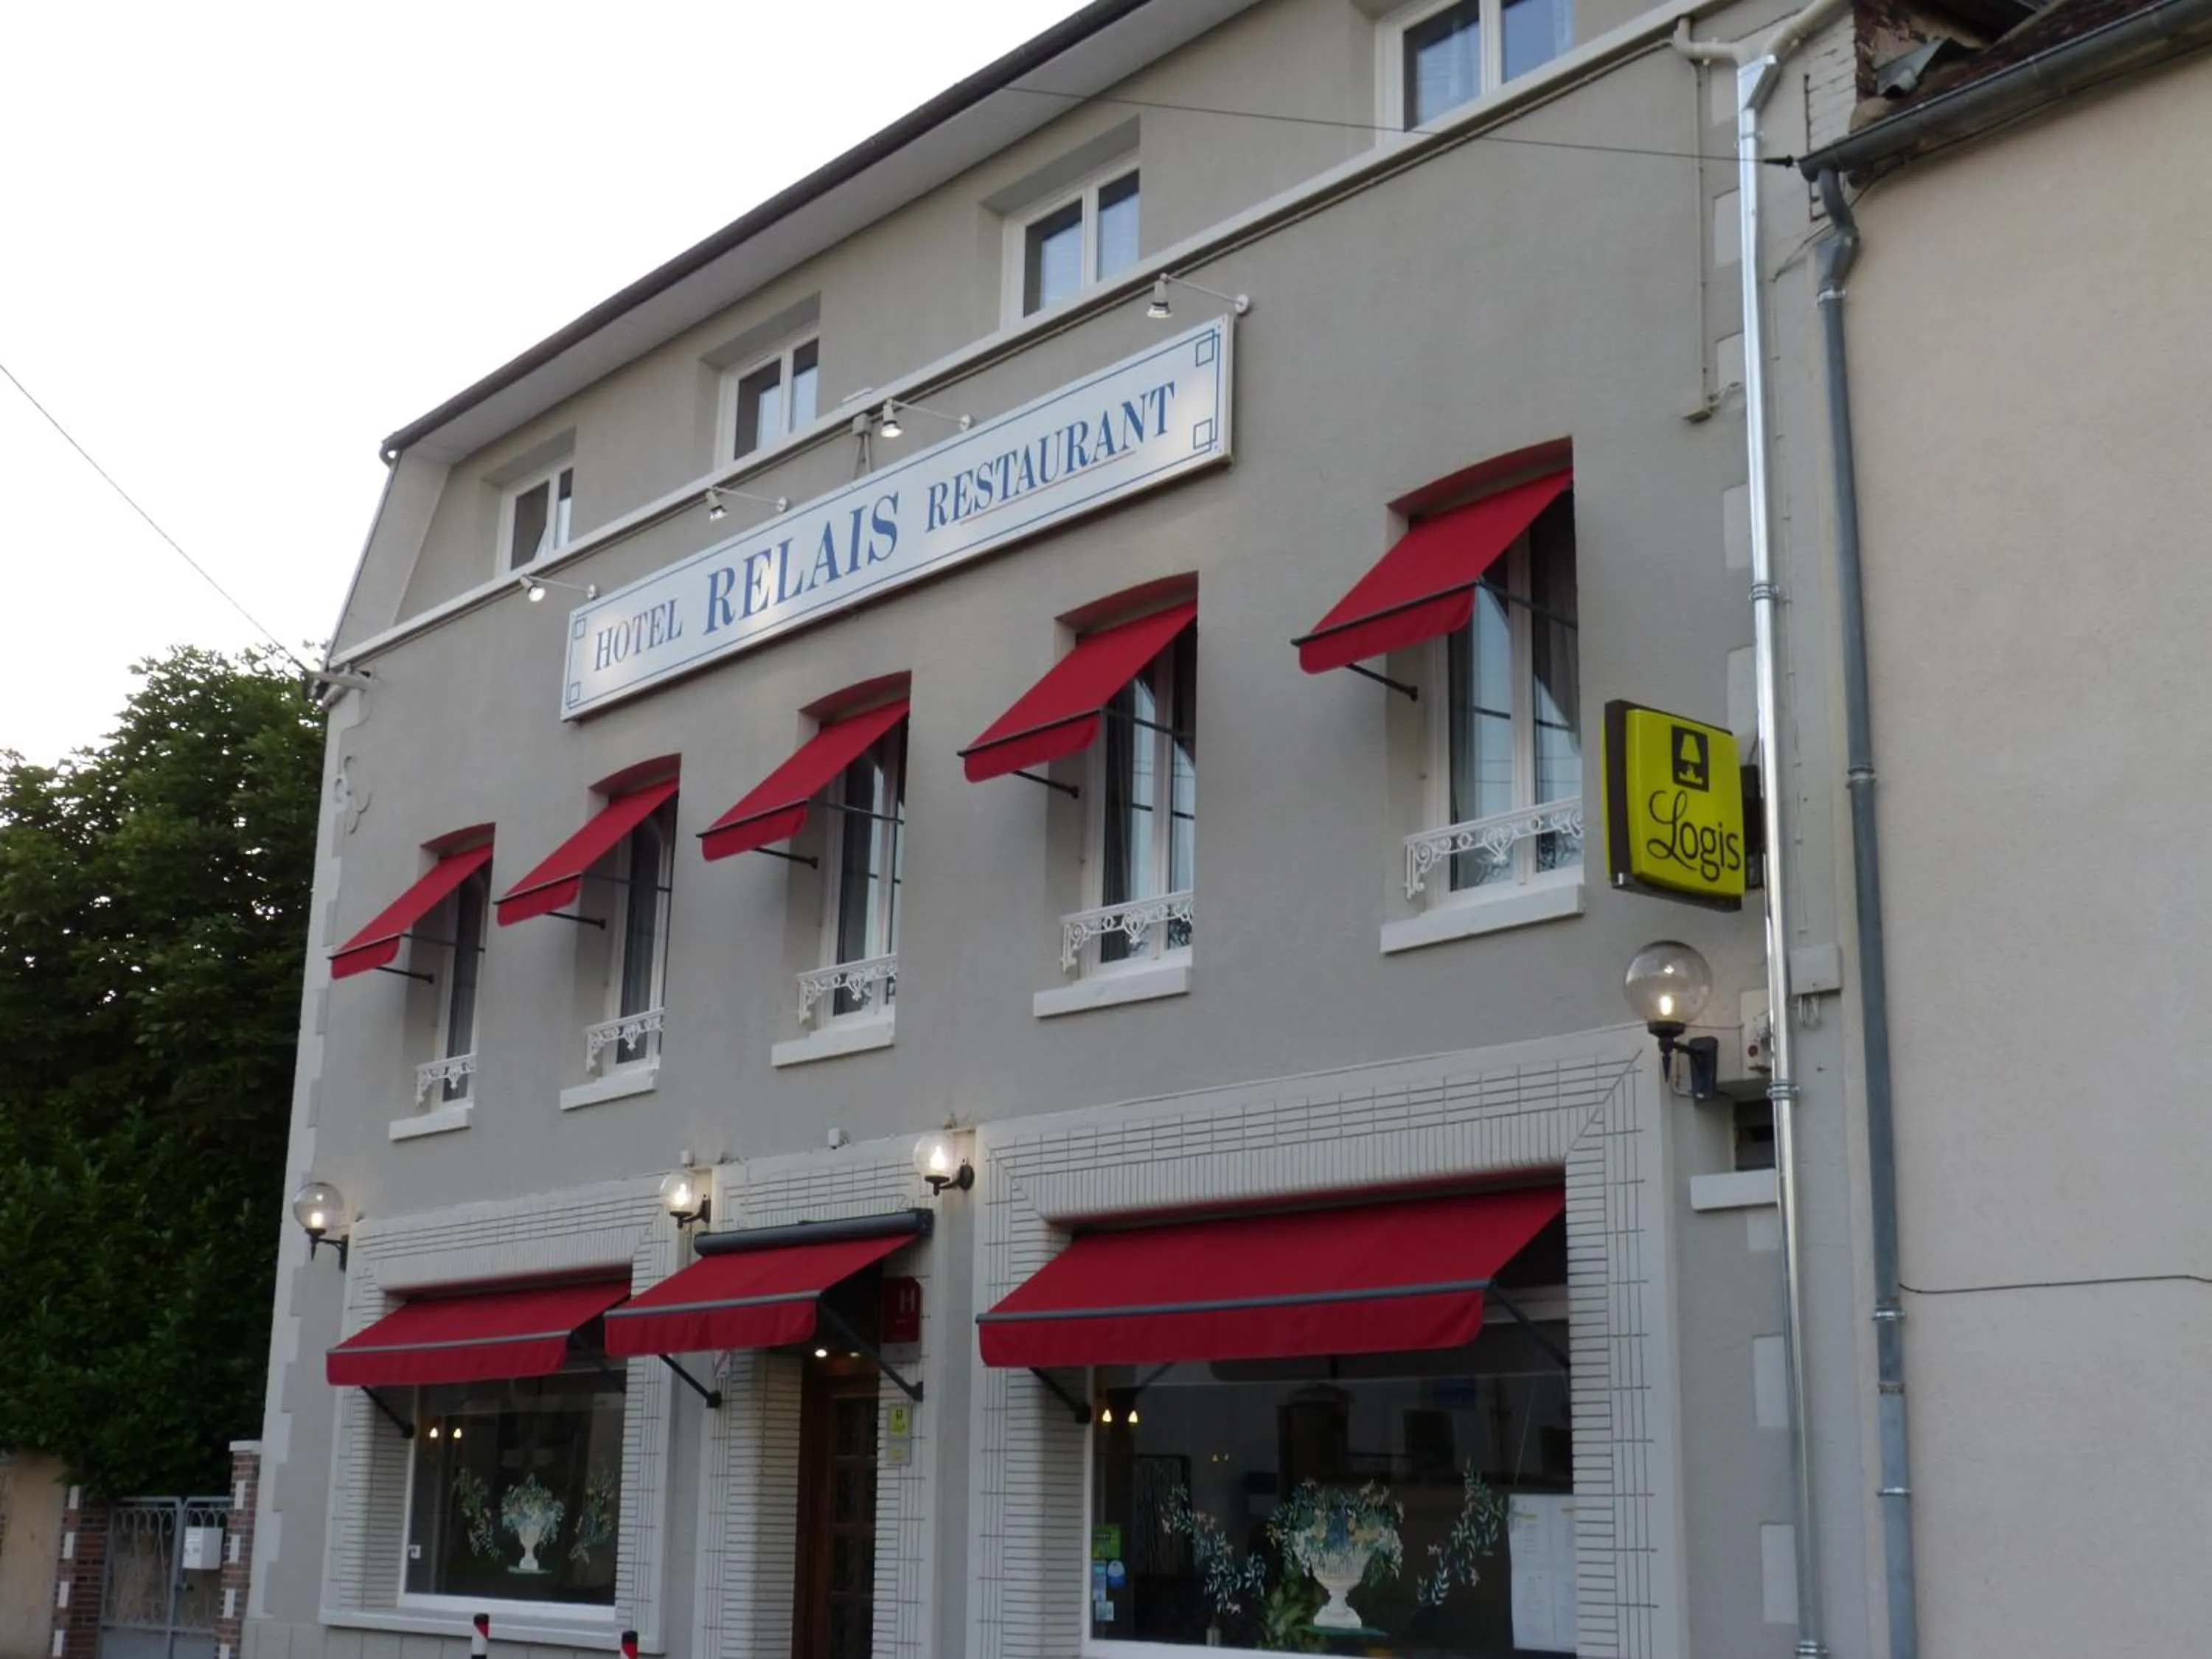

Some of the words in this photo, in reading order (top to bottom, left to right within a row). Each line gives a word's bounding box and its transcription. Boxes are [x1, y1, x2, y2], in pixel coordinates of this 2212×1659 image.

[594, 597, 683, 672] HOTEL
[702, 490, 900, 636] RELAIS
[925, 380, 1175, 533] RESTAURANT
[1646, 790, 1741, 882] Logis
[899, 1287, 916, 1314] H
